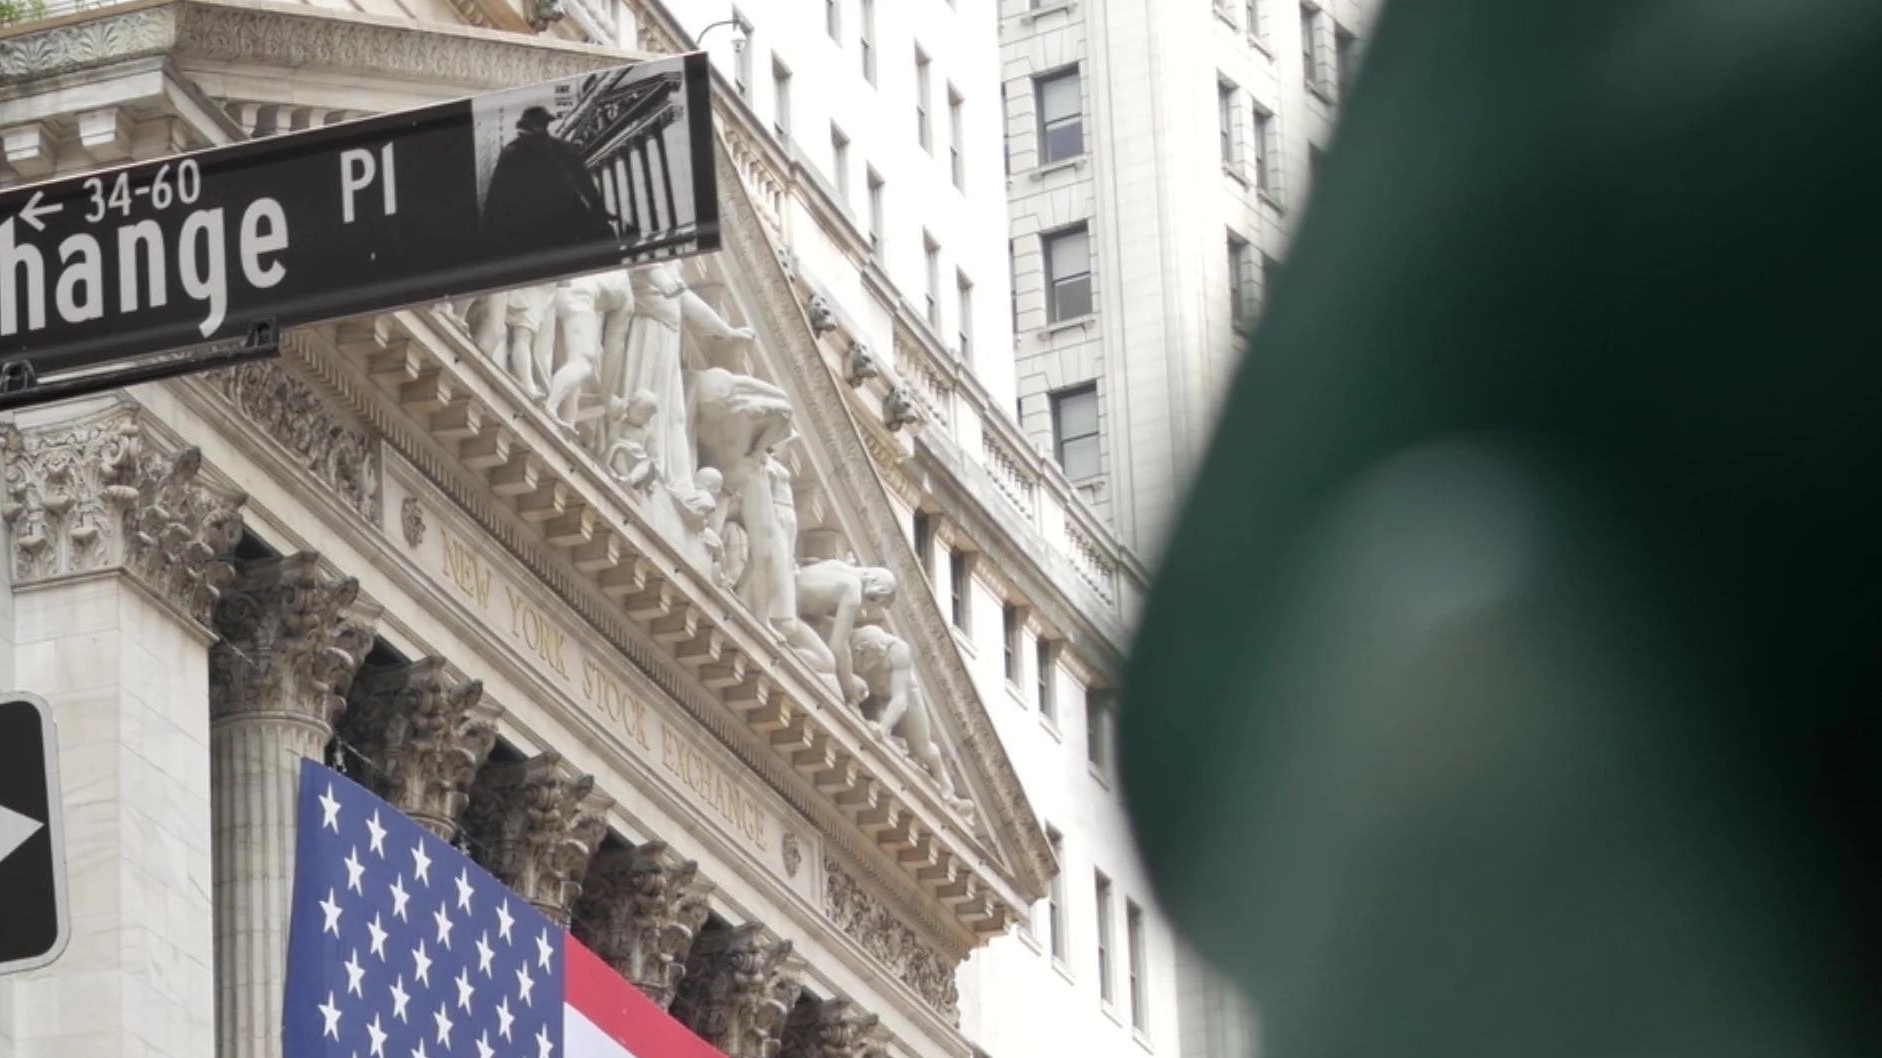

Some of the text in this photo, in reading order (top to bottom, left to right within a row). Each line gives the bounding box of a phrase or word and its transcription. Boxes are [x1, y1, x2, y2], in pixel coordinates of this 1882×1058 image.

[83, 158, 202, 224] 34-60
[440, 528, 767, 852] NEW YORK STOCK EXCHANGE
